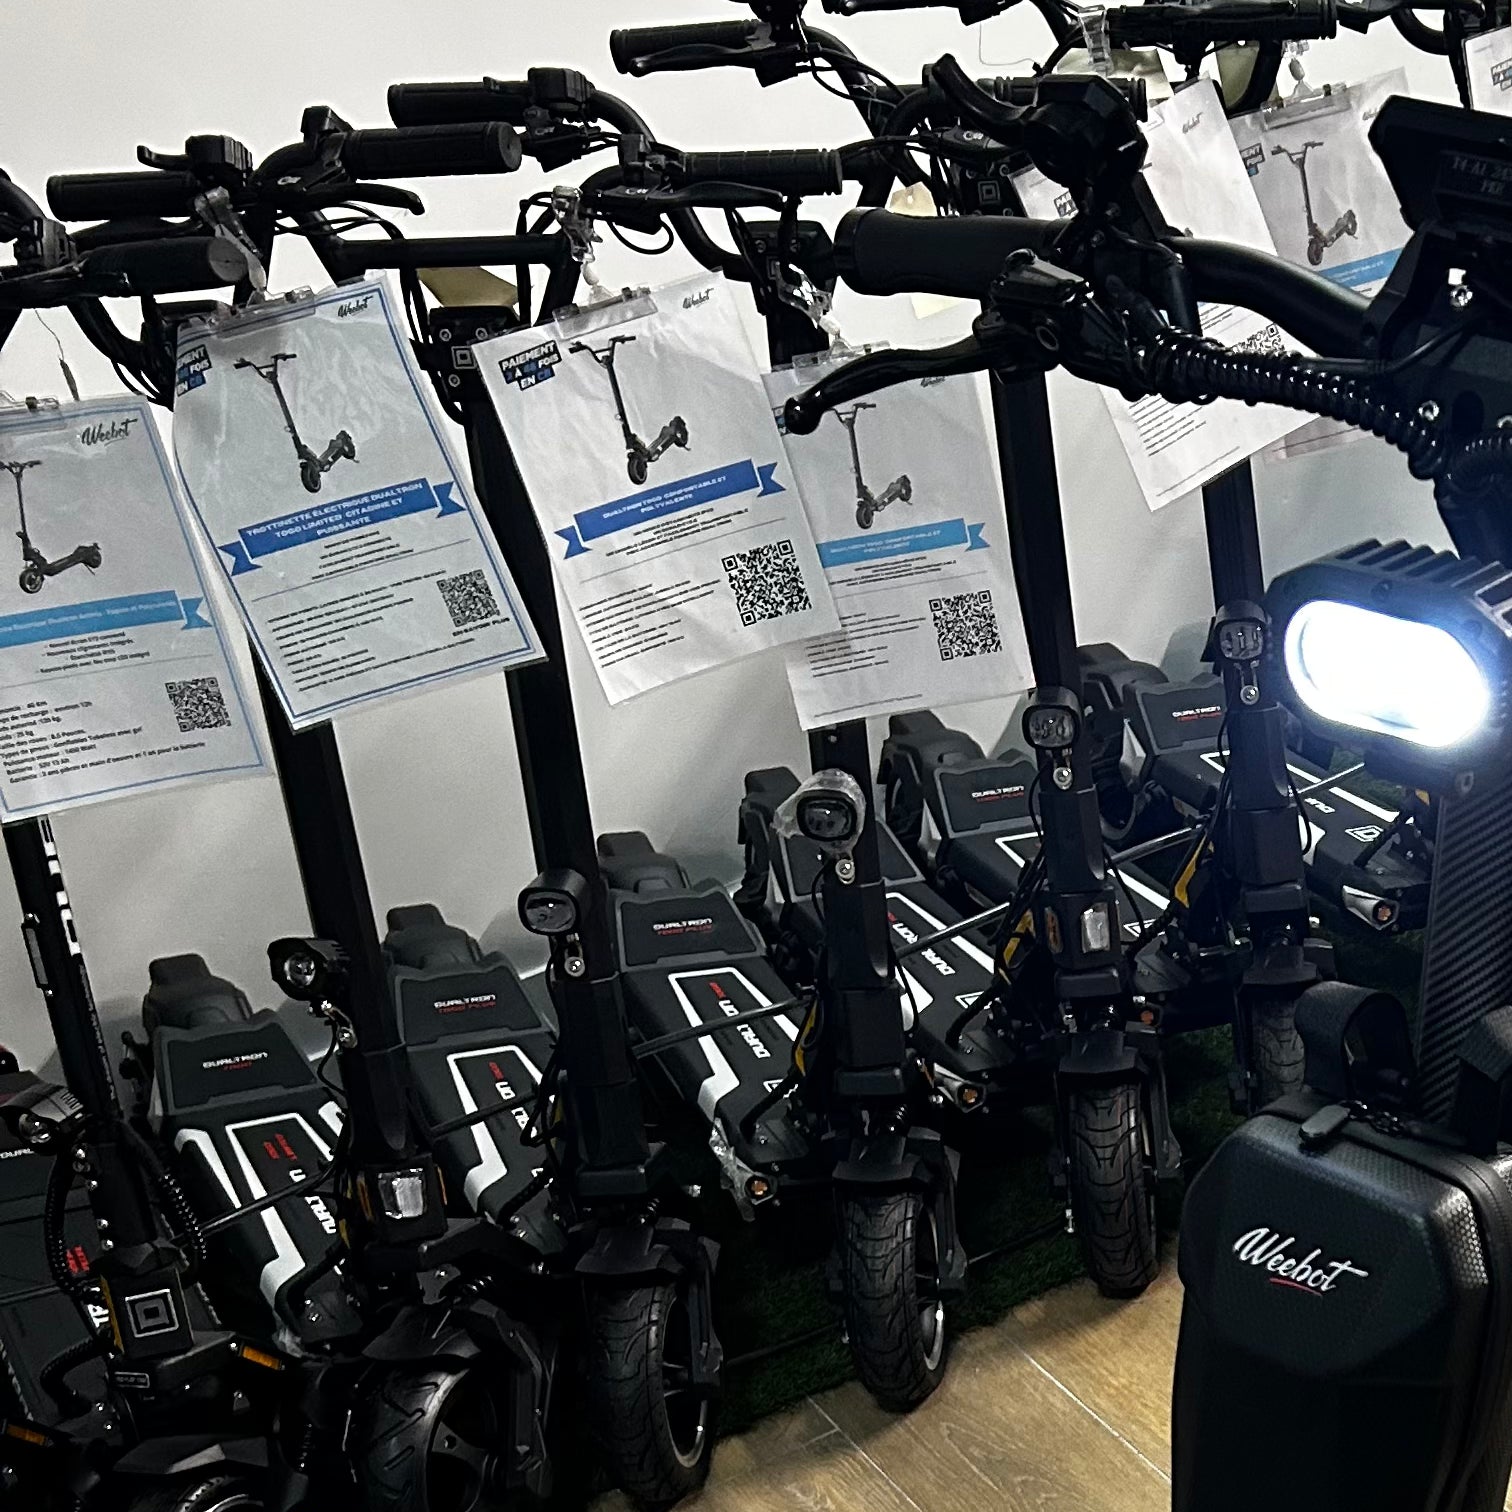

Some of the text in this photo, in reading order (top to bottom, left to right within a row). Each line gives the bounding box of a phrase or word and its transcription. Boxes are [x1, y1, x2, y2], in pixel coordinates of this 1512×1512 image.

[501, 341, 556, 371] PAIEMENT
[538, 353, 559, 369] FOIS
[520, 374, 536, 389] EN
[81, 418, 138, 446] Weebot
[653, 918, 713, 931] DUALTRON
[434, 994, 496, 1009] DUALTRON
[203, 1052, 268, 1069] DUALTRON
[1232, 1227, 1369, 1292] Weebot
